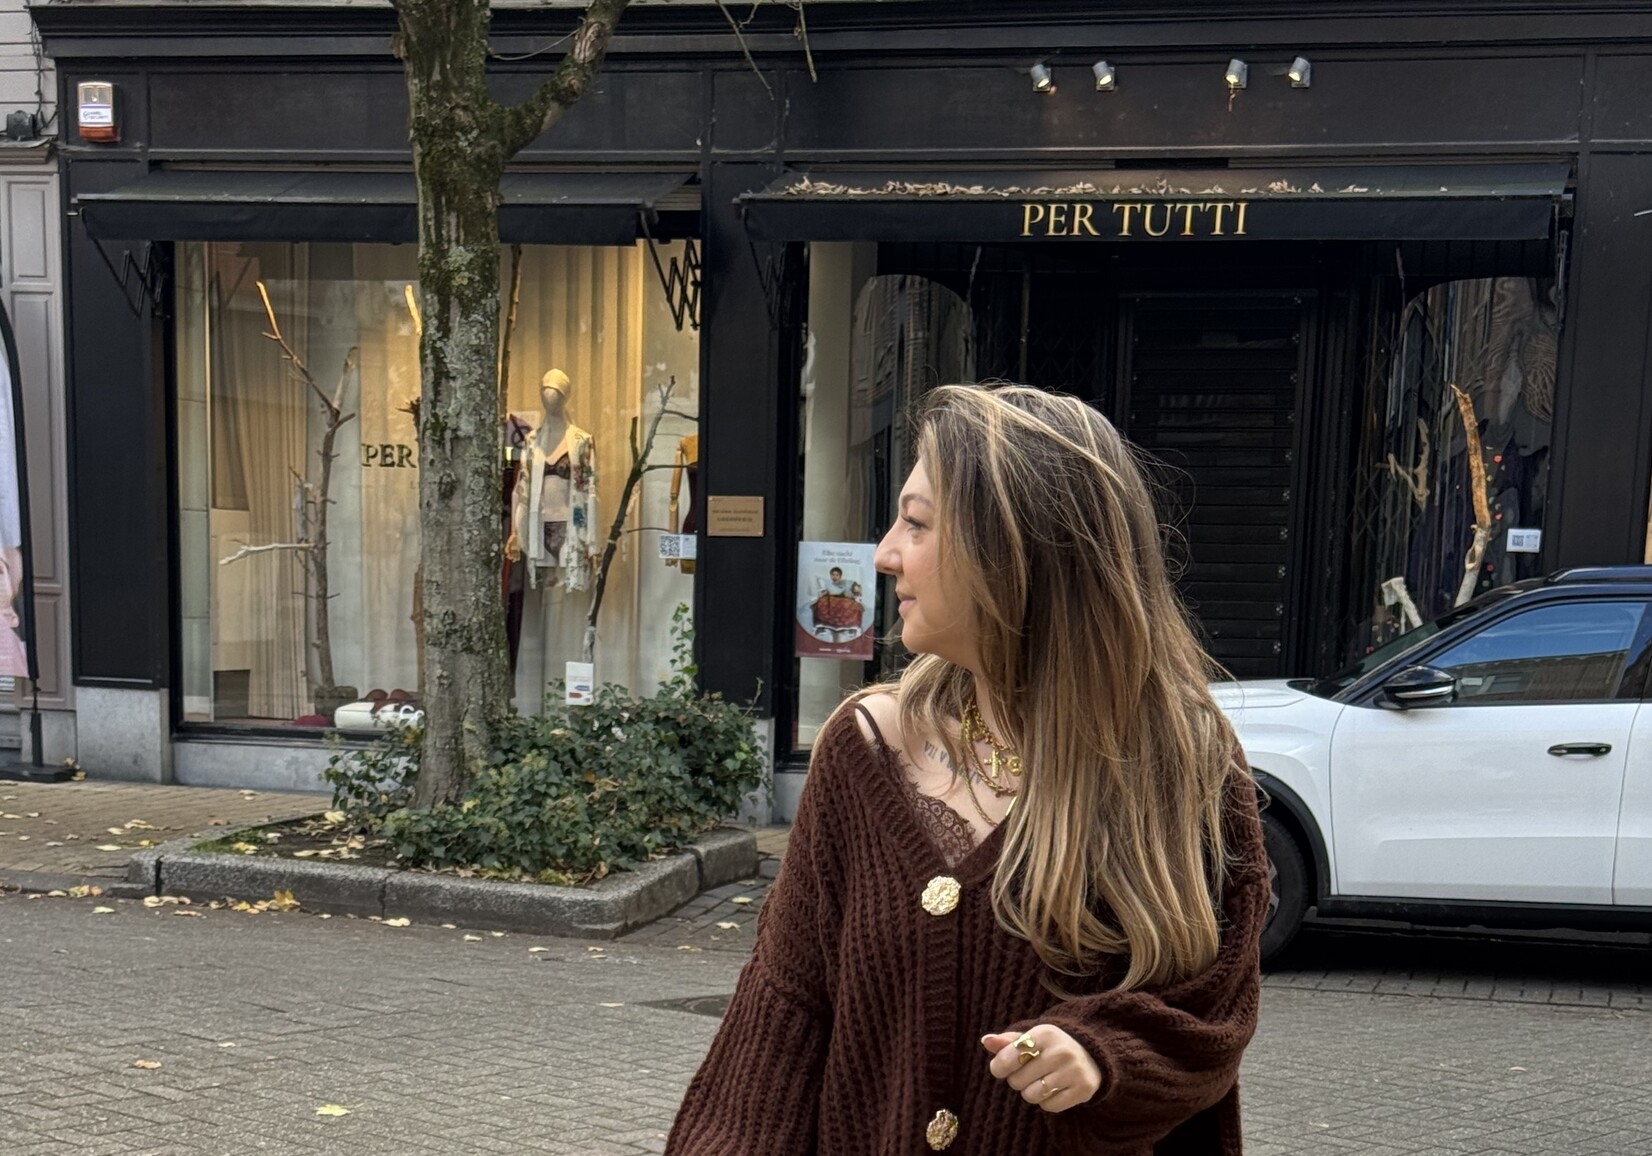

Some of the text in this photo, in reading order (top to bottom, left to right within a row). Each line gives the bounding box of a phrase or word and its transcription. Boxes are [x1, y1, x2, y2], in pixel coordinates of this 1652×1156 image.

[1019, 202, 1249, 237] PER TUTTI
[361, 443, 417, 469] PER
